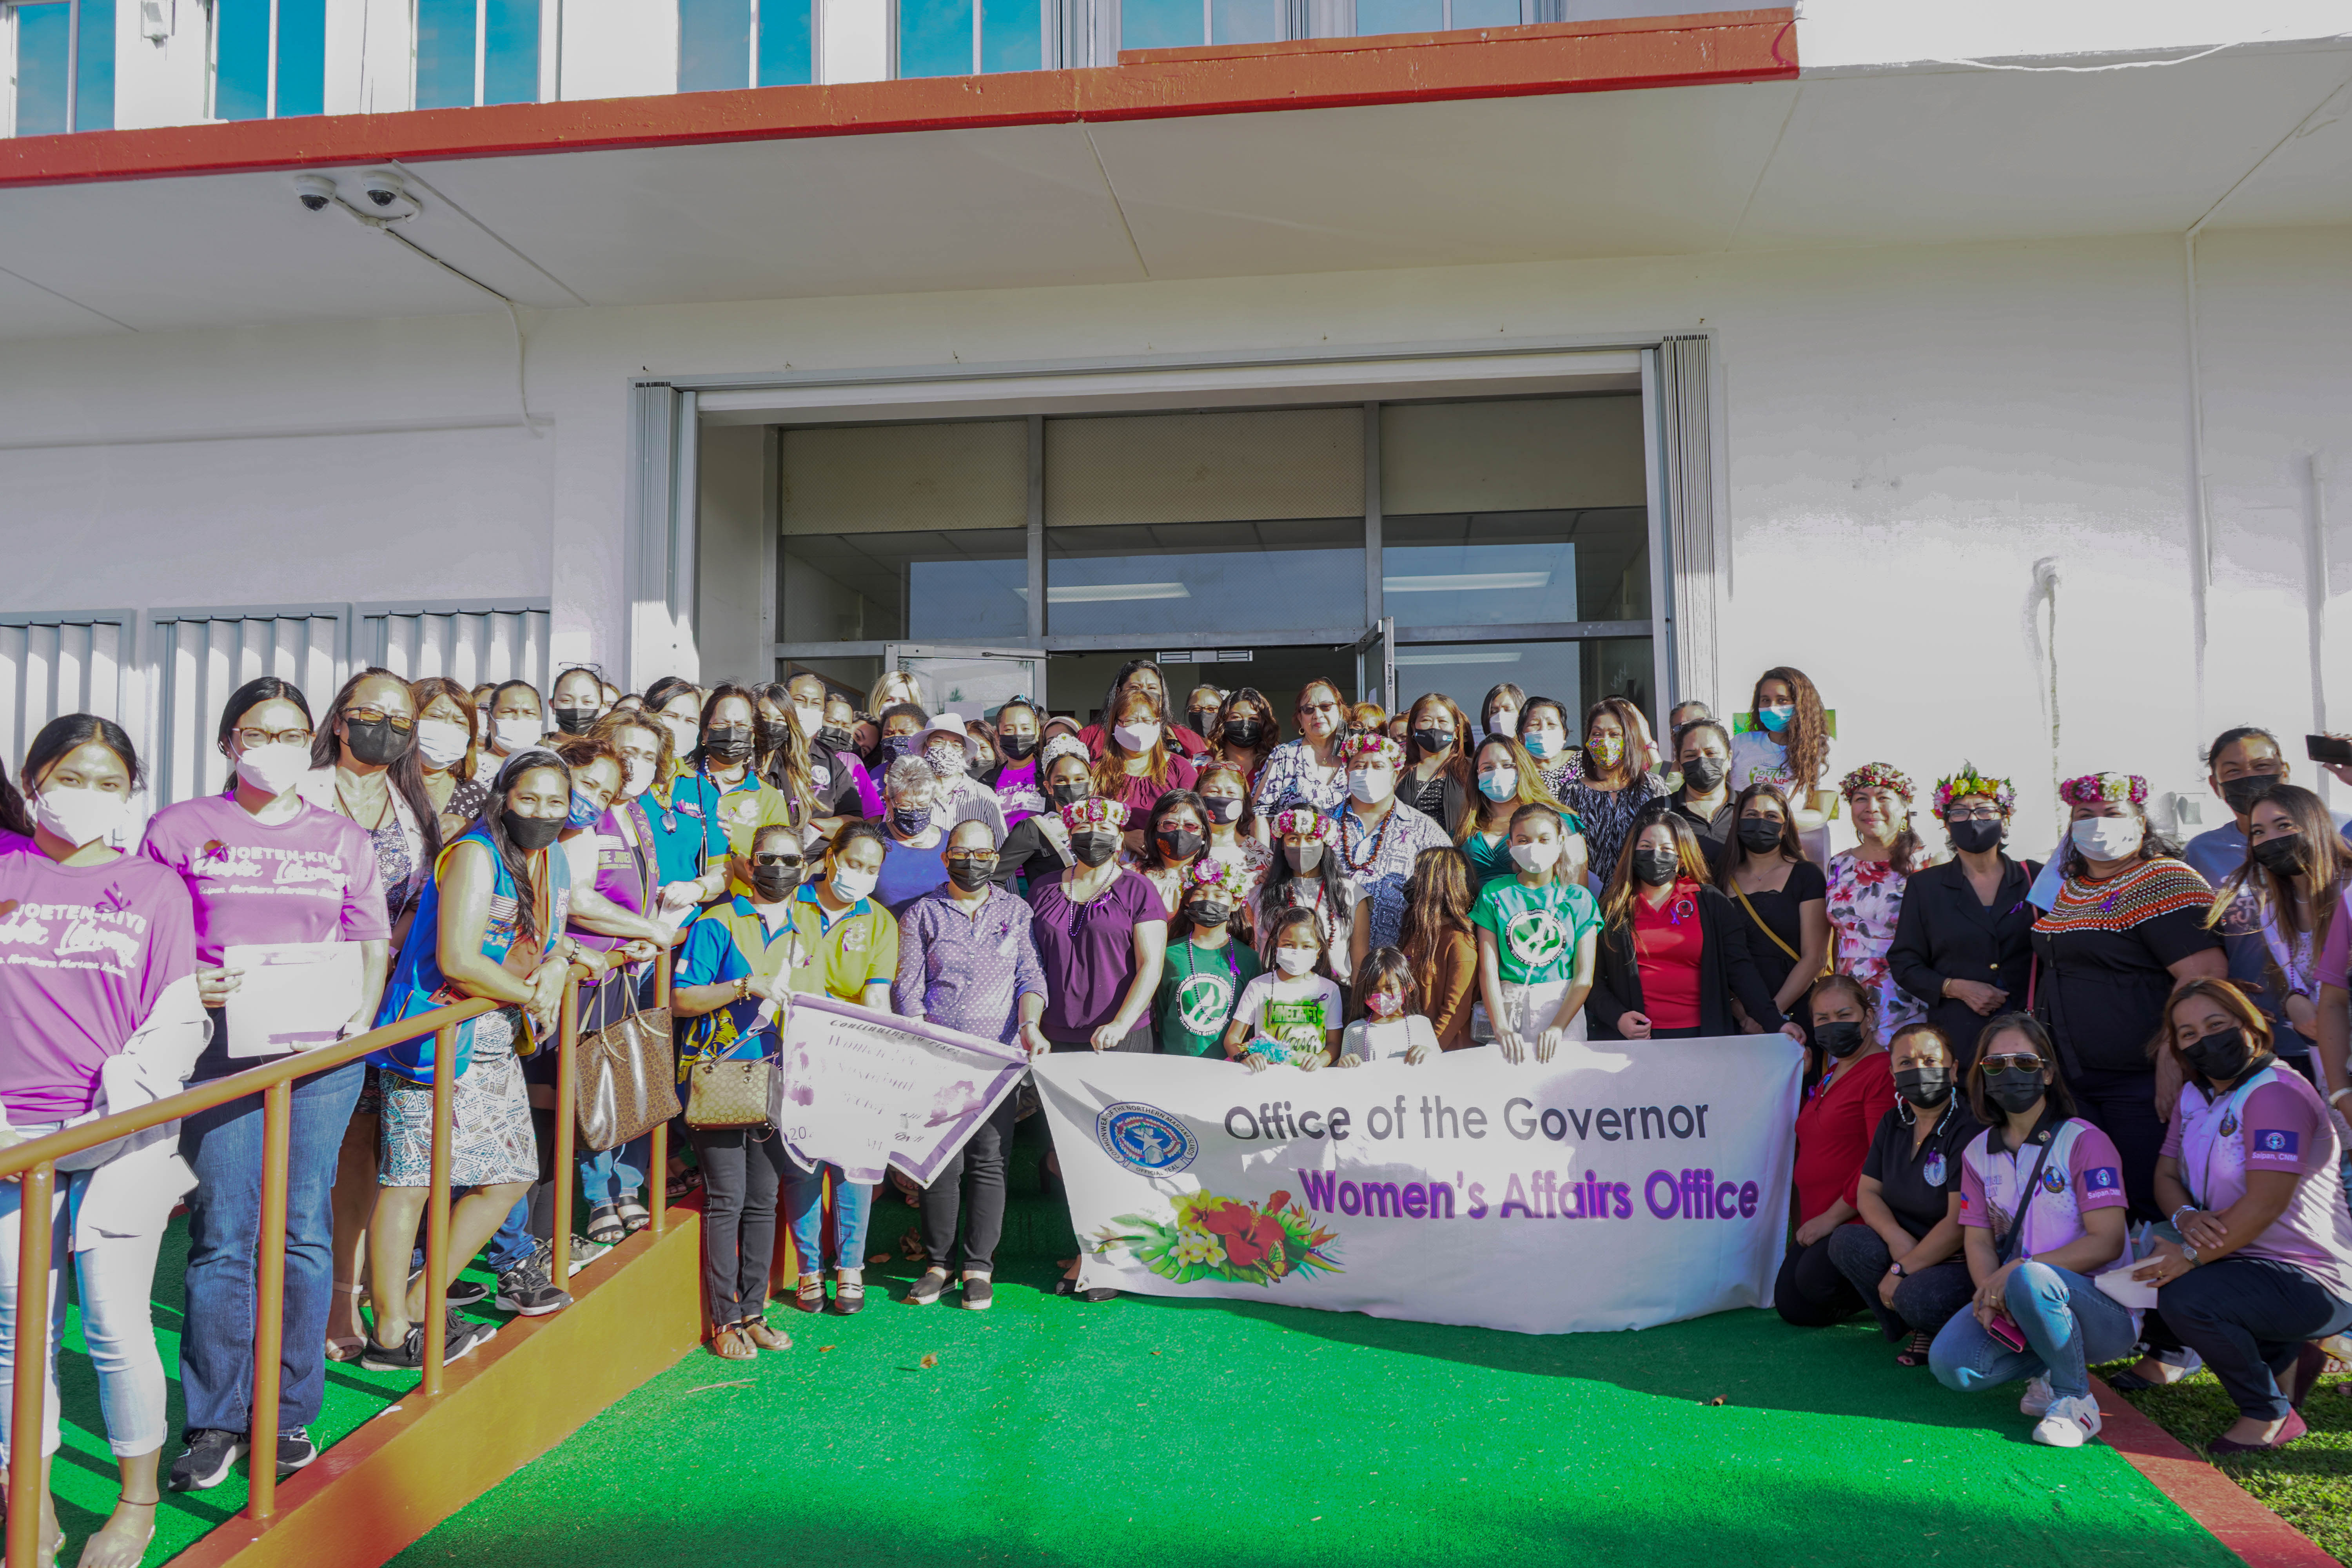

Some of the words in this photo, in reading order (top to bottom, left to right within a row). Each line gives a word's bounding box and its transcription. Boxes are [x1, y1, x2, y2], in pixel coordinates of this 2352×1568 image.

[830, 1020, 907, 1040] Continuing
[929, 1040, 960, 1054] rise:
[1179, 1016, 1190, 1030] Where
[1189, 1027, 1202, 1036] Girls
[1106, 1110, 1114, 1118] OF
[1126, 1105, 1165, 1118] NORTHERN
[1165, 1117, 1191, 1138] MARIANA
[1187, 1138, 1195, 1156] ISLANDS
[1225, 1101, 1351, 1140] Office
[1367, 1095, 1406, 1140] of
[1420, 1095, 1488, 1139] the
[1504, 1097, 1708, 1141] Governor
[1136, 1167, 1163, 1176] OFFICIAL
[1165, 1163, 1180, 1172] SEAL
[1298, 1168, 1489, 1219] Women's
[1500, 1169, 1633, 1220] Affairs
[1644, 1169, 1759, 1220] Office
